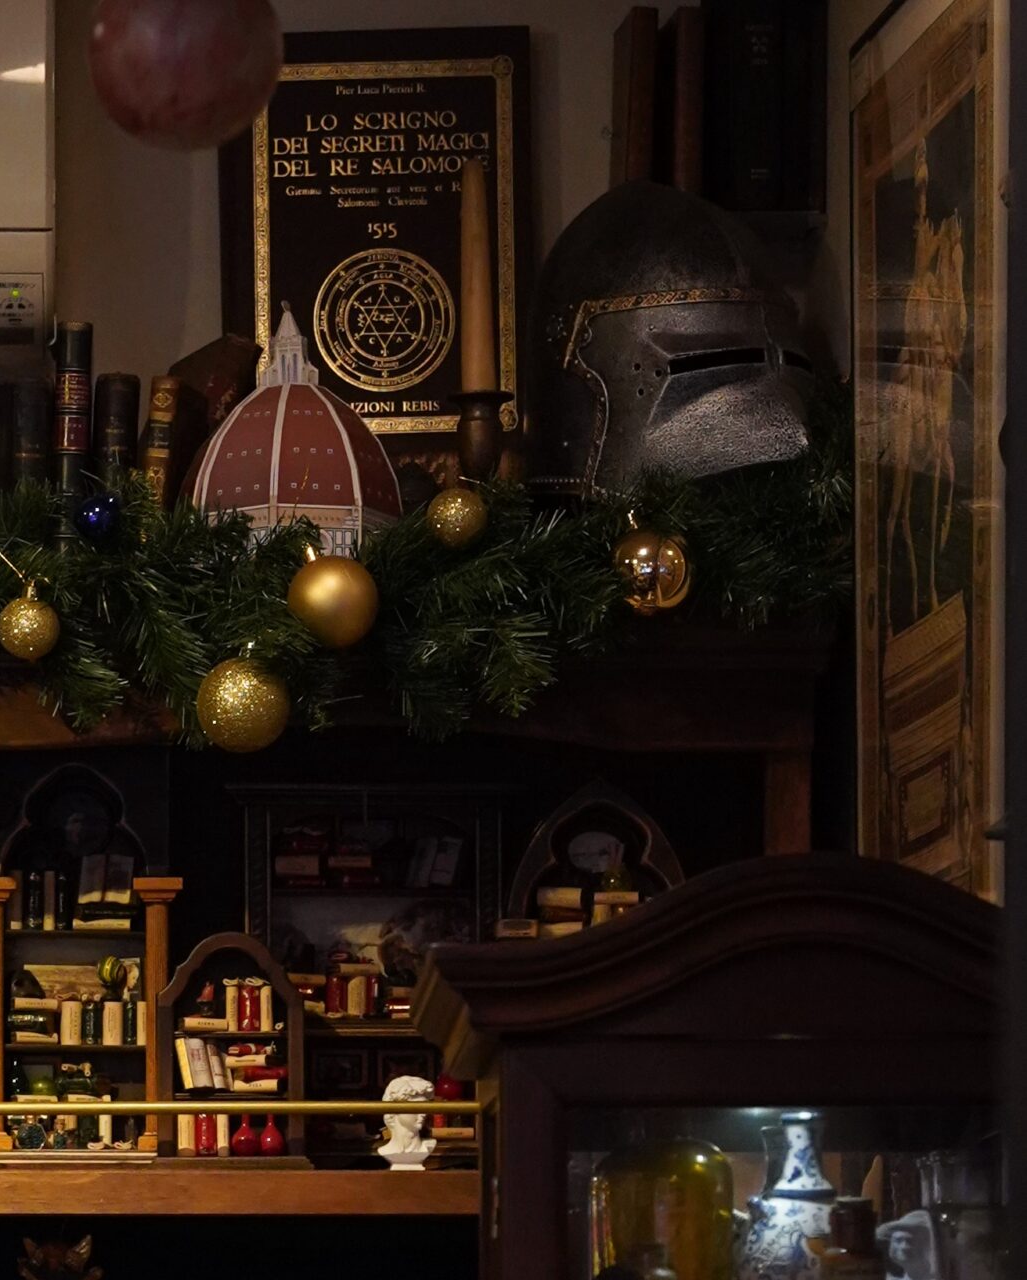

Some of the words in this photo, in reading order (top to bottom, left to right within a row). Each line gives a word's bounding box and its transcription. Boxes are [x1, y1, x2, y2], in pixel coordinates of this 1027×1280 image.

[335, 85, 354, 96] Pier
[357, 84, 380, 95] Luca
[382, 83, 414, 95] Pierini
[306, 114, 338, 132] LO
[353, 110, 457, 130] SCRIGNO
[274, 137, 309, 155] DEI
[320, 134, 405, 154] SEGRETI
[417, 132, 490, 151] MAGICI
[274, 160, 317, 178] DEL
[330, 158, 360, 176] RE
[368, 222, 398, 239] 1515
[350, 401, 395, 413] IZIONI
[402, 400, 441, 413] REBIS
